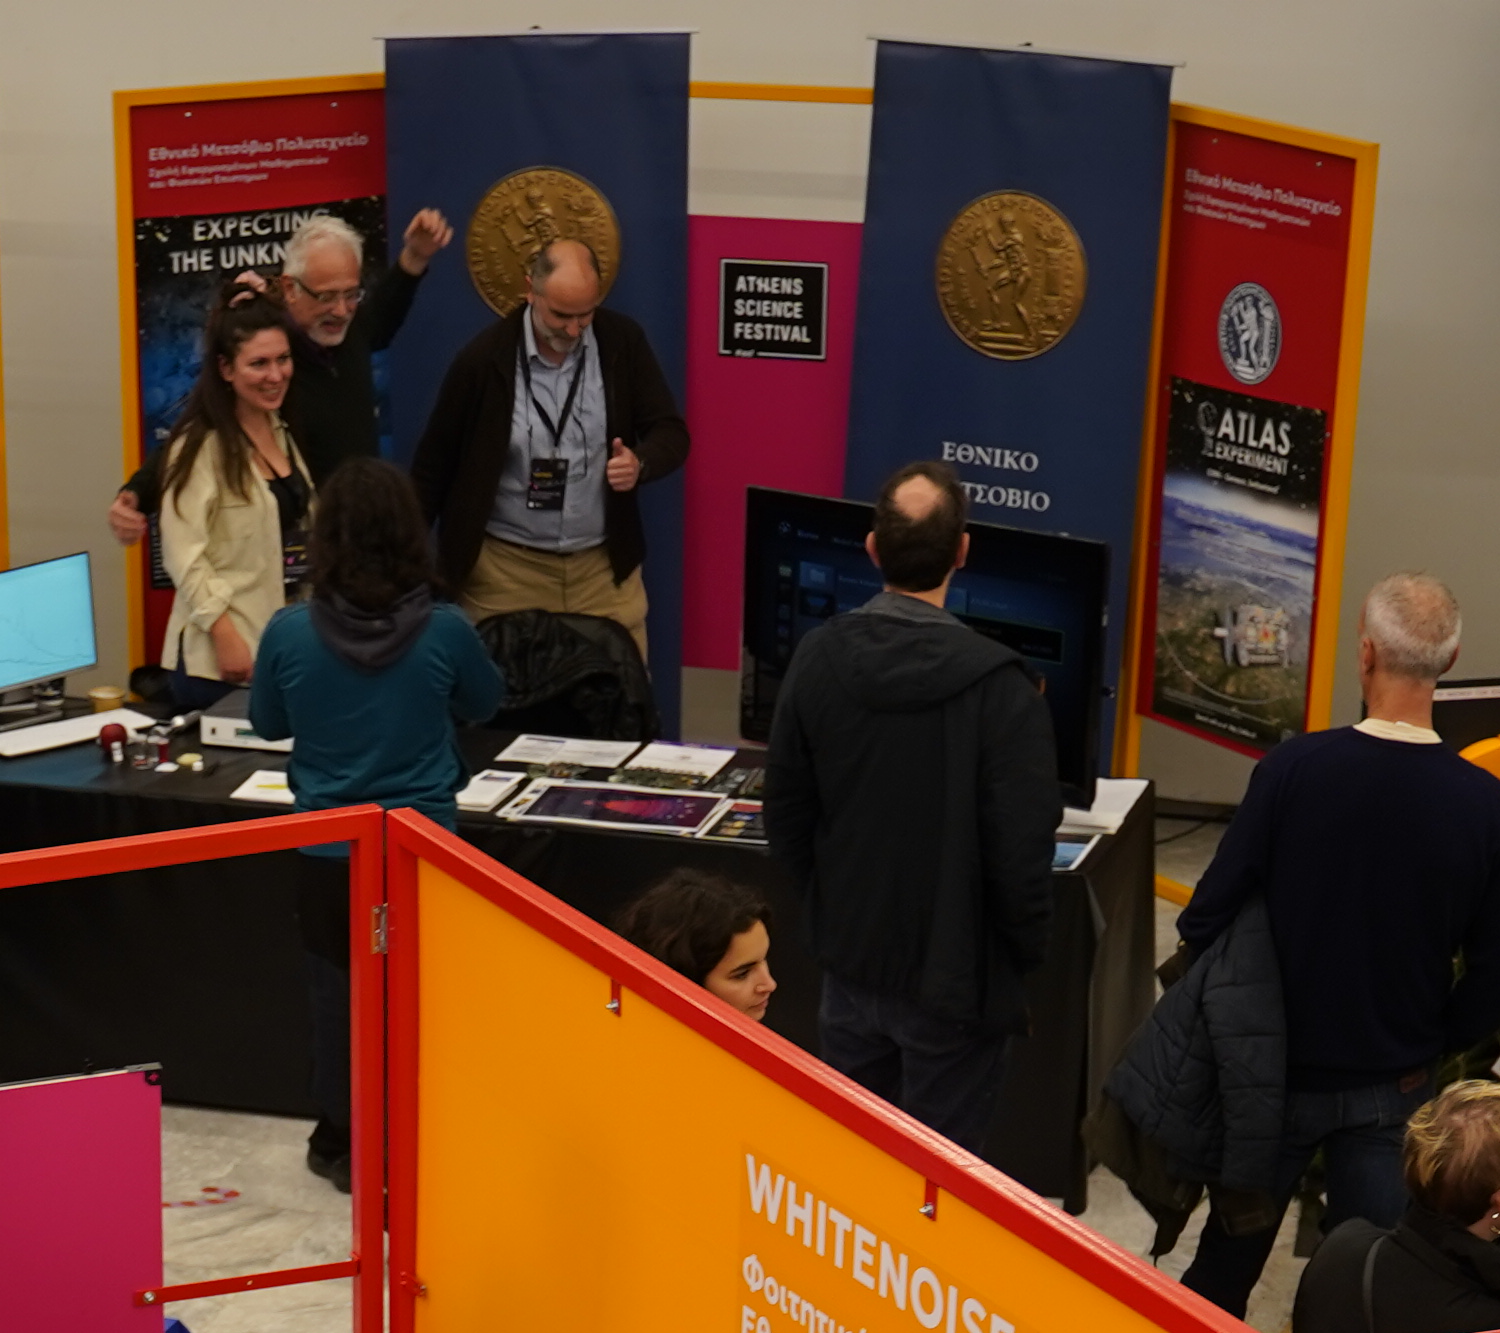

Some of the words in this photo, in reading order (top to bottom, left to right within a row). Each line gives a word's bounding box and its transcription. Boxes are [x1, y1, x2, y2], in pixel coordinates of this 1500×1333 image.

[169, 250, 214, 275] THE
[219, 241, 288, 271] UNKN
[735, 274, 804, 296] ATHENS
[733, 297, 804, 319] SCIENCE
[733, 321, 812, 344] FESTIVAL
[1216, 406, 1292, 457] ATLAS
[942, 440, 1039, 473] ΕΘΝΙΚΟ
[1214, 443, 1290, 478] EXPERIMENT
[959, 480, 1051, 513] ΤΣΟΒΙΟ
